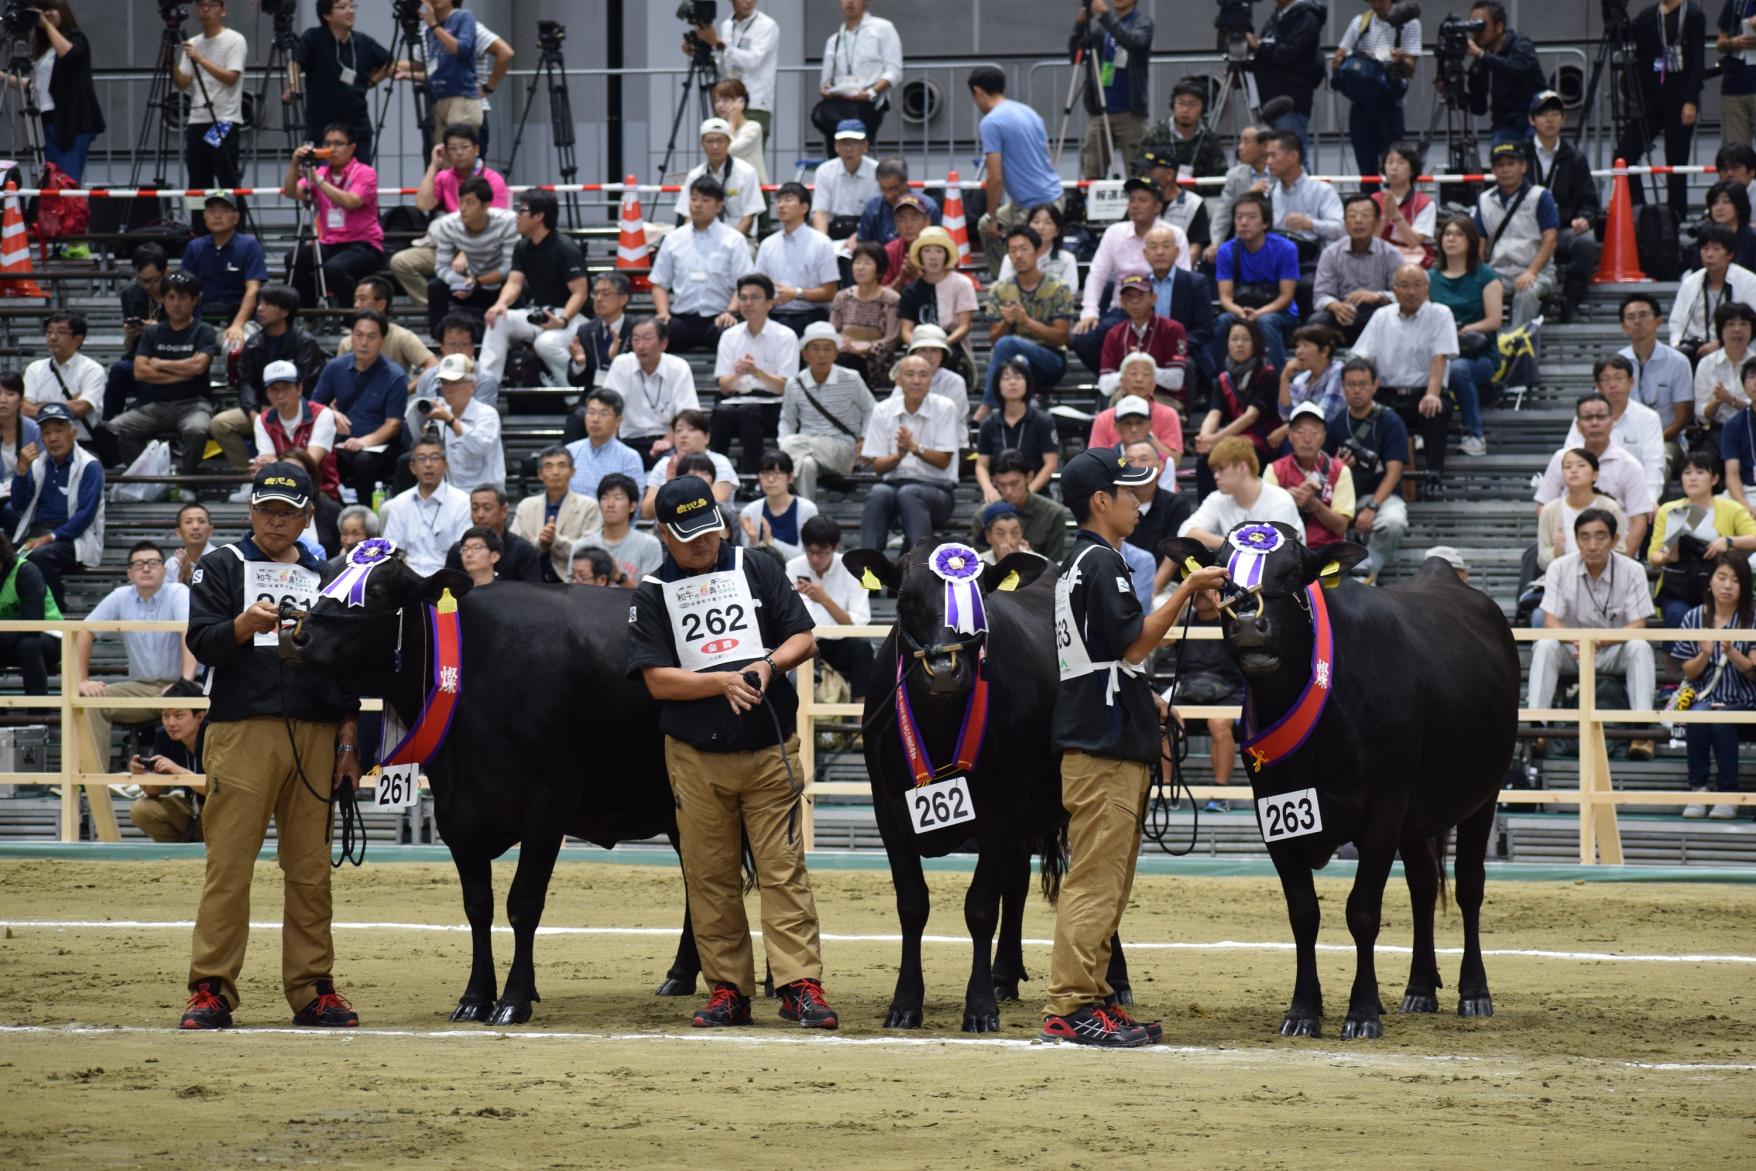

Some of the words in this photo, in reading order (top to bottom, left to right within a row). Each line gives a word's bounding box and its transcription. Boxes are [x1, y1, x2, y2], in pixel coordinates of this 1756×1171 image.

[682, 604, 748, 642] 262
[1054, 618, 1071, 649] 63
[379, 772, 412, 805] 261
[915, 787, 968, 828] 262
[1266, 797, 1315, 837] 263
